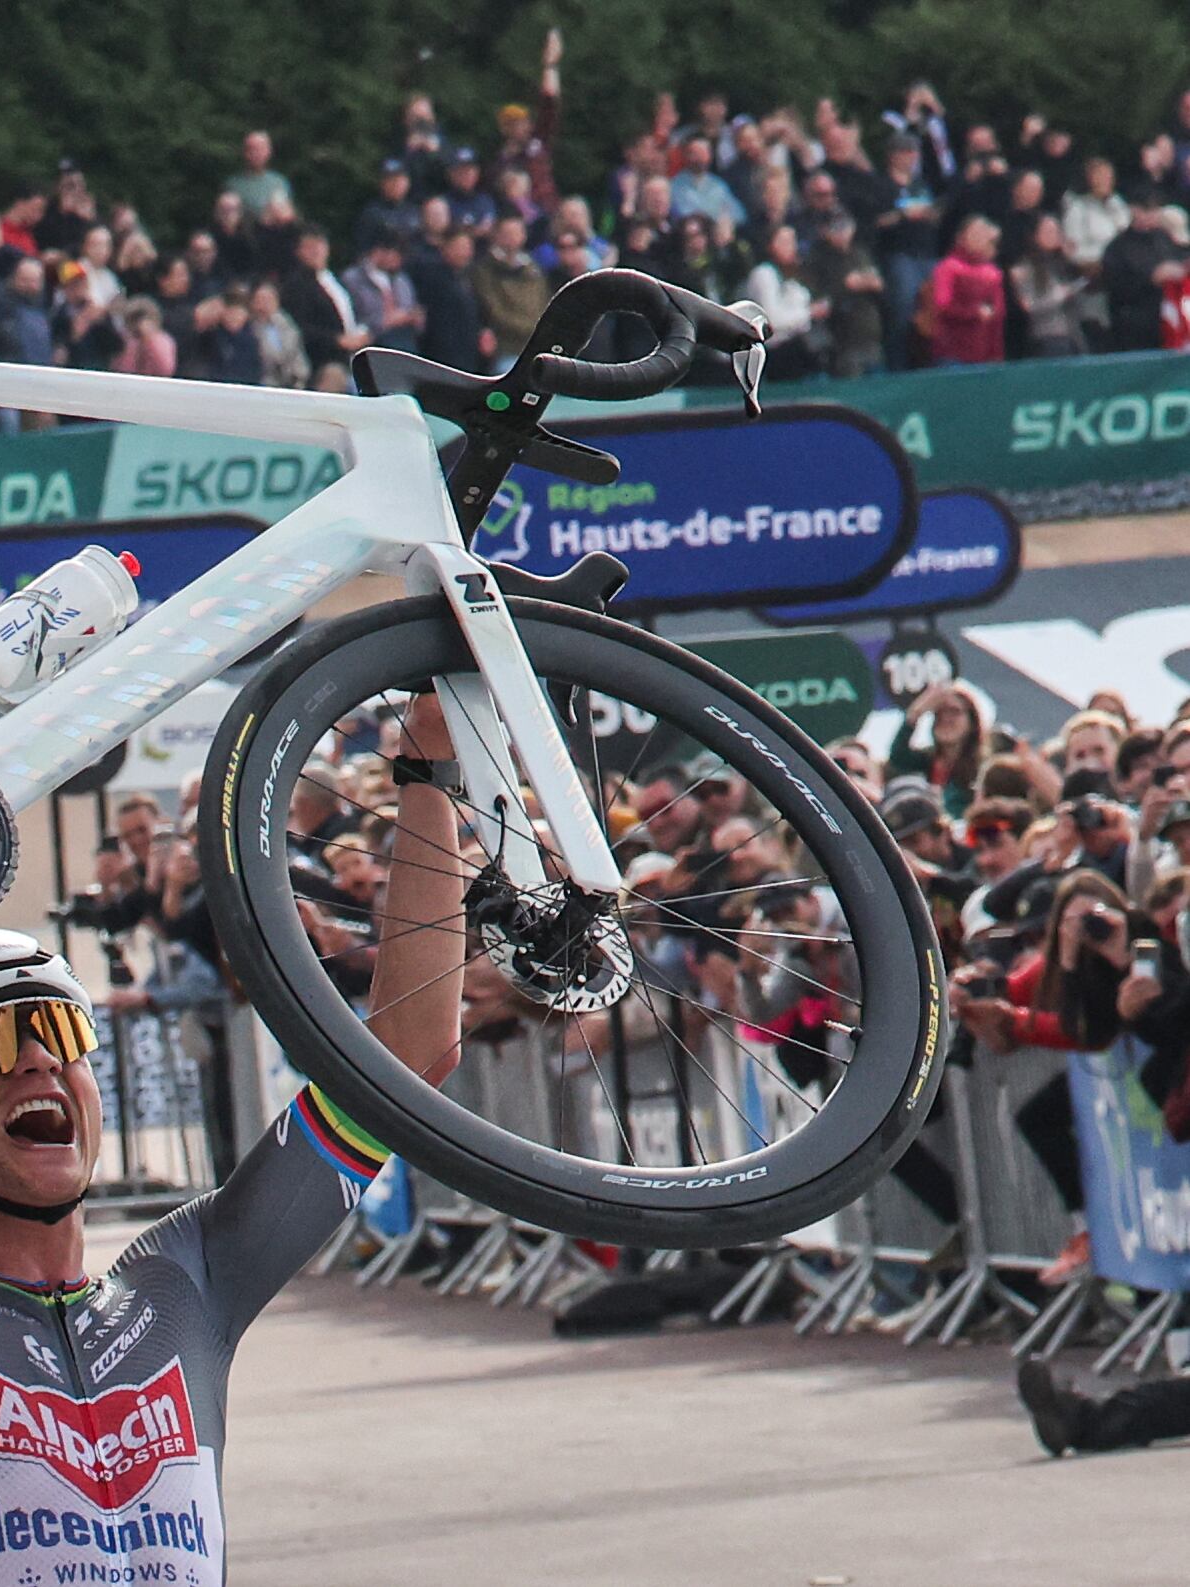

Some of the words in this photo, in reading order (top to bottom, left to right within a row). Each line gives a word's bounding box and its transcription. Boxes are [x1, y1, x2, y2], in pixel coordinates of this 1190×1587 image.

[547, 481, 656, 513] Région
[550, 504, 883, 558] Hauts-de-France
[222, 750, 241, 829] PIRELLI
[260, 718, 301, 859] DURA-ACE
[703, 704, 844, 837] DURA-ACE
[925, 1001, 939, 1057] ZERO
[601, 1165, 769, 1190] DURA-ACE
[53, 1561, 178, 1585] WINDOWS
